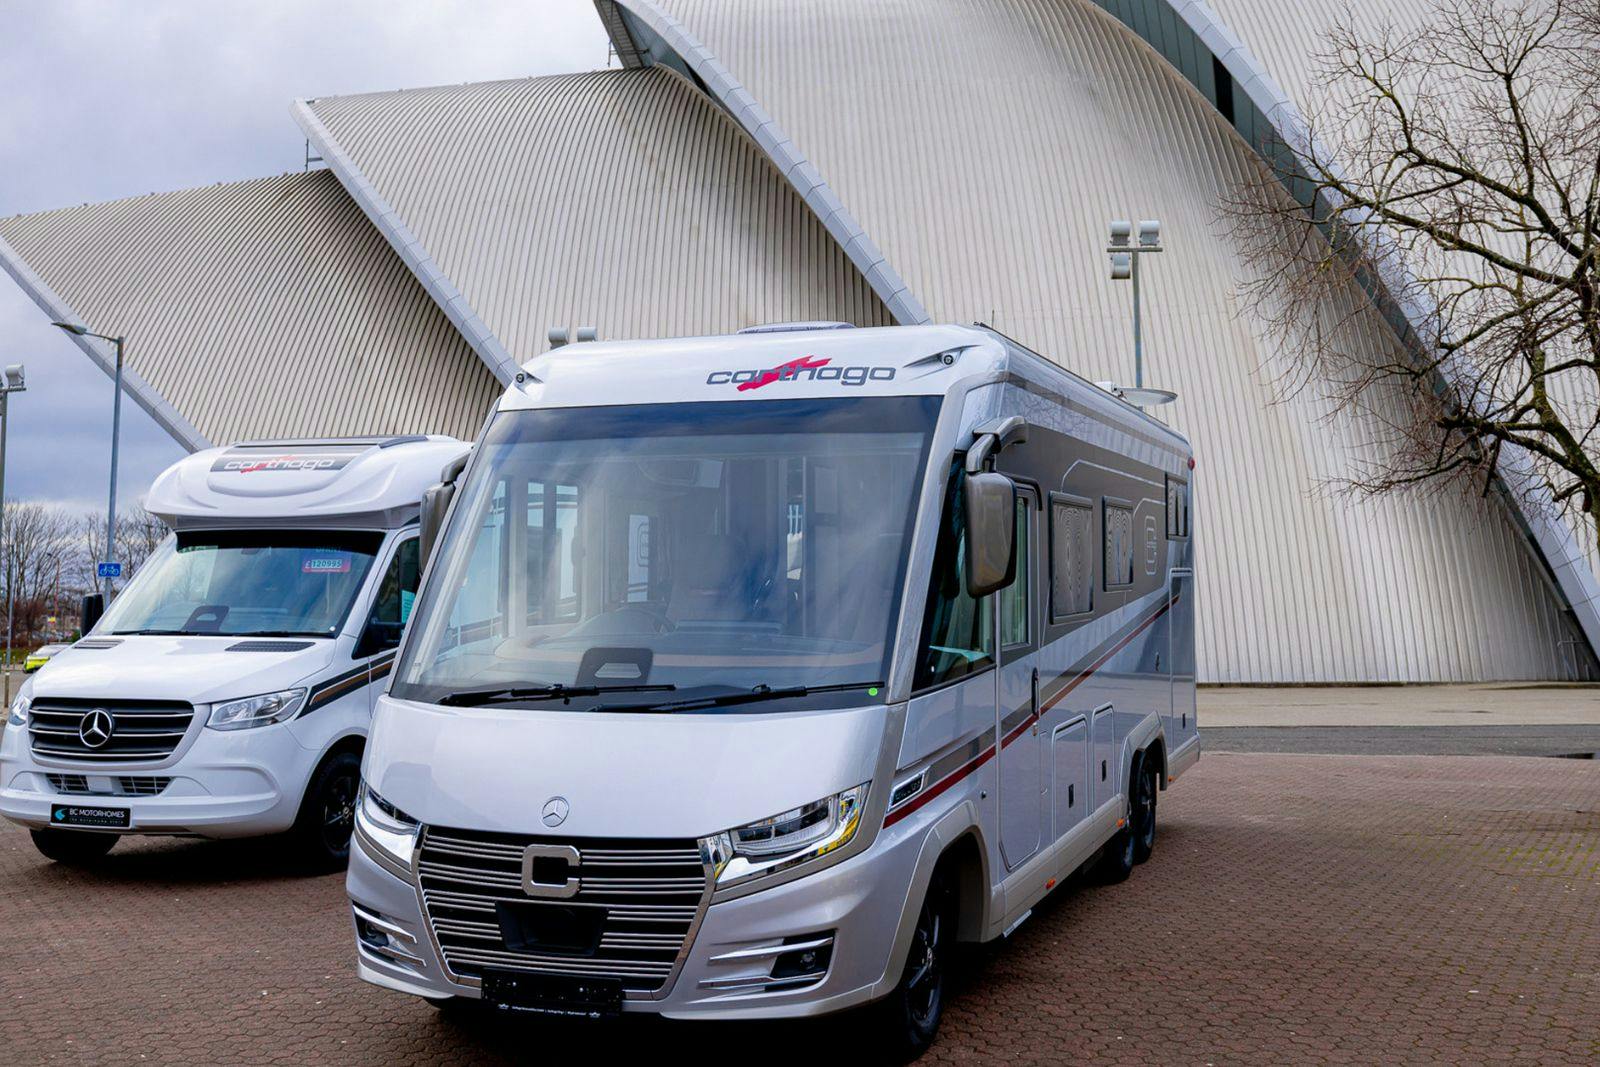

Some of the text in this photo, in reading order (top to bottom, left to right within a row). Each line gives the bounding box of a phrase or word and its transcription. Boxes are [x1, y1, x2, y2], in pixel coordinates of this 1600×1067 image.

[706, 363, 897, 387] carthago
[224, 458, 336, 471] carthago
[69, 808, 125, 818] BC MOTORHOMES
